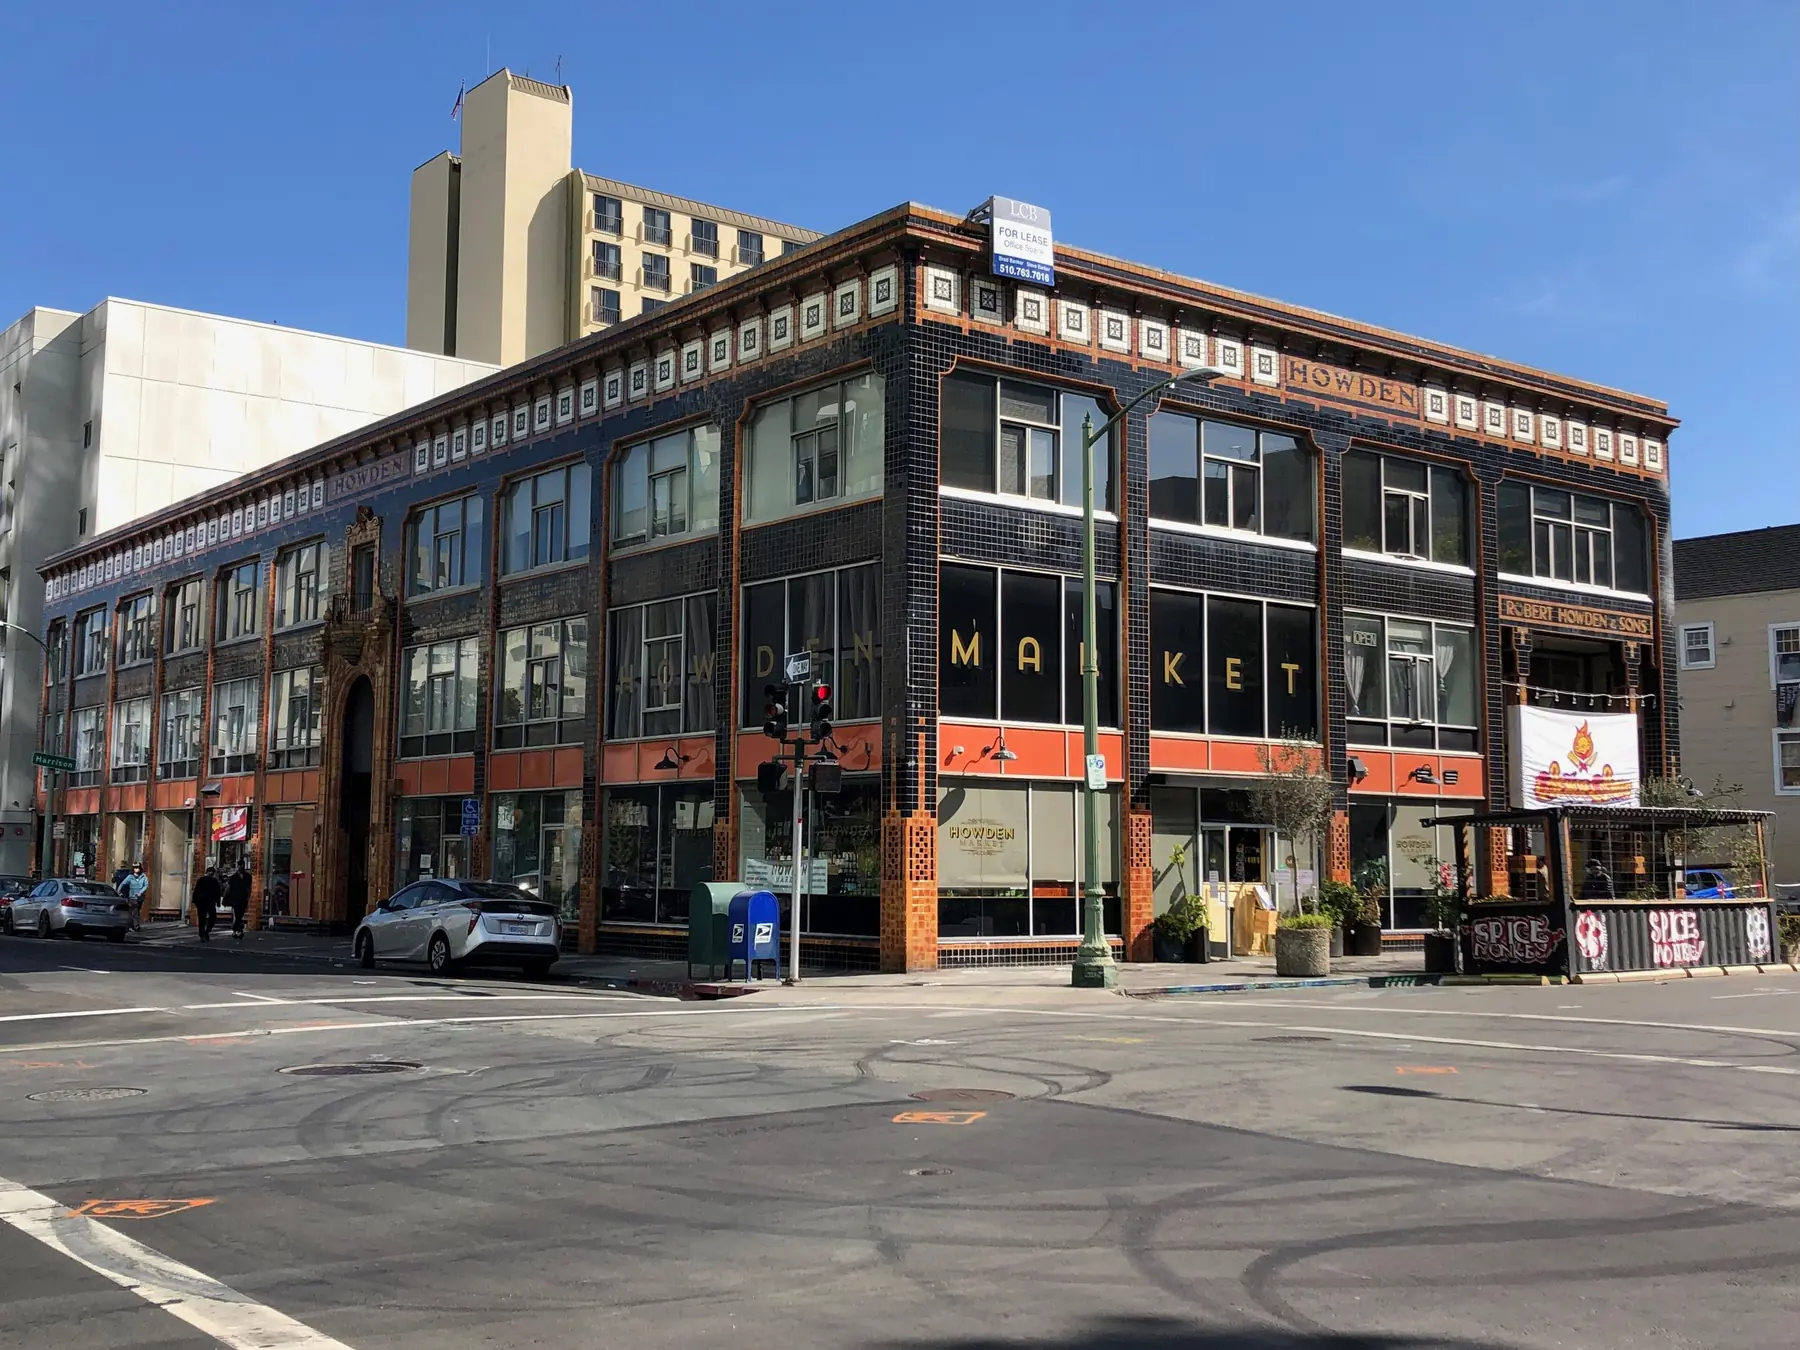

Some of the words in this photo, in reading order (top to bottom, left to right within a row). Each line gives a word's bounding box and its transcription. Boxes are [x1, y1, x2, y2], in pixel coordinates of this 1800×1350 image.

[1010, 201, 1038, 220] LCB
[999, 227, 1018, 239] FOR
[1021, 231, 1048, 247] LEASE
[1003, 240, 1023, 251] Office
[1289, 360, 1416, 408] HOWDEN
[333, 457, 404, 496] HOWDEN
[1506, 600, 1553, 621] ROBERT
[1557, 607, 1608, 629] HOWDEN
[1619, 616, 1649, 633] SONS
[1355, 631, 1377, 646] OPEN
[792, 662, 800, 674] ONE
[800, 660, 808, 673] WAY
[35, 755, 73, 769] Harrison
[949, 826, 1015, 840] HOWDEN
[960, 840, 1004, 848] MARKET
[1474, 919, 1550, 945] SPICE
[1649, 910, 1700, 943] SPICE
[1653, 940, 1705, 965] MONKEY
